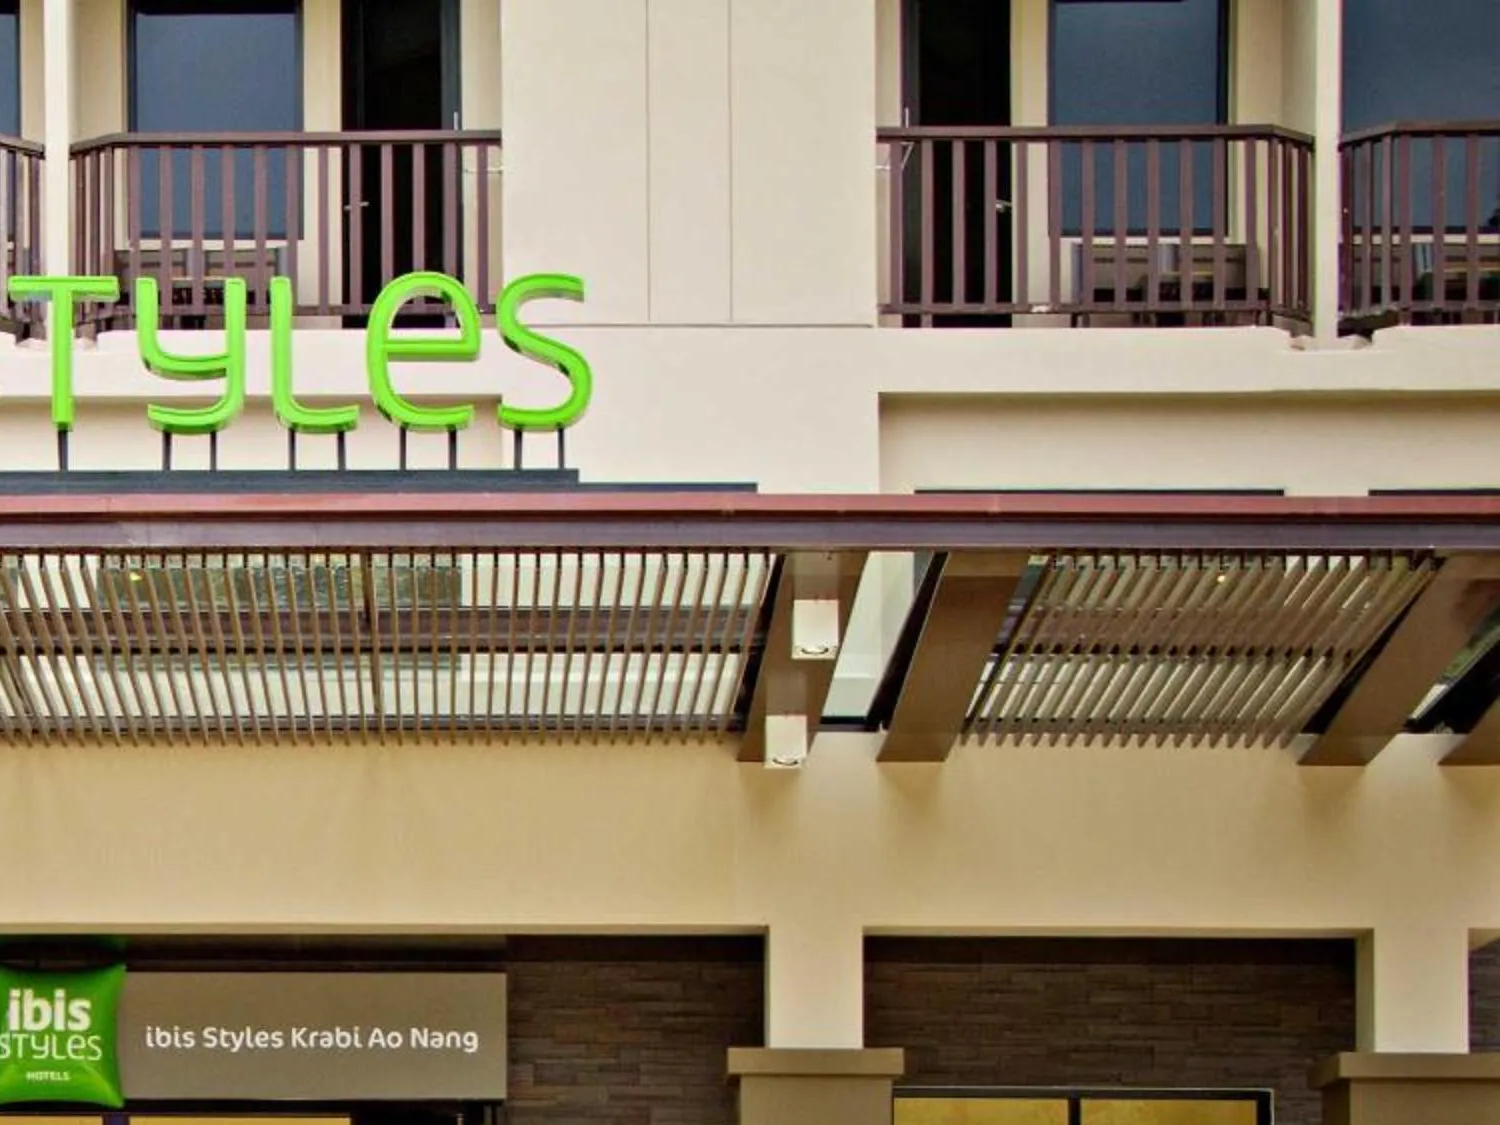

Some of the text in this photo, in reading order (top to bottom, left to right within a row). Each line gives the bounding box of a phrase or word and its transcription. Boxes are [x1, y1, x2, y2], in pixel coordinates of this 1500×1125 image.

[8, 987, 92, 1032] ibis
[145, 1025, 480, 1053] ibis Styles Krabi Ao Nang
[26, 1071, 70, 1081] HOTELS
